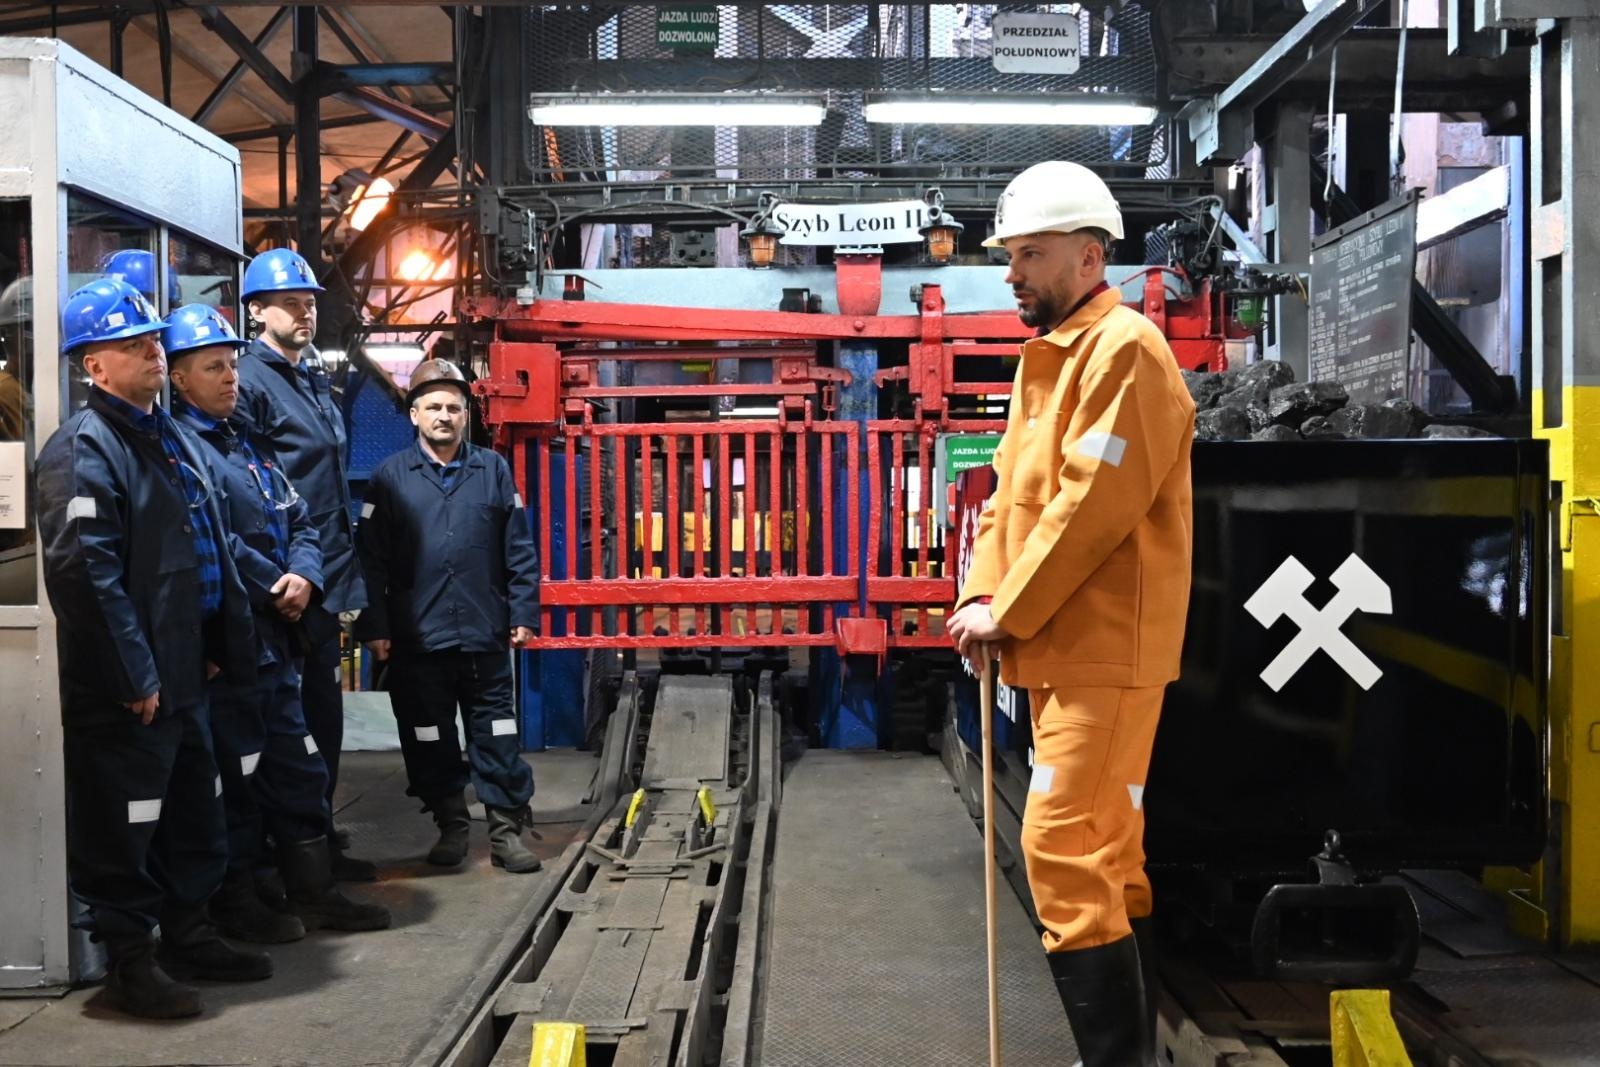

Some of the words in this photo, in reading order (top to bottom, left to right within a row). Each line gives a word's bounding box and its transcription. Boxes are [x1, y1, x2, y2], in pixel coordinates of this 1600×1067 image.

[659, 11, 689, 23] JAZDA
[690, 11, 718, 23] LUDZI
[659, 31, 717, 43] DOZWOLONA
[1002, 27, 1069, 37] PRZEDZIAŁ
[994, 47, 1077, 57] POŁUDNIOWY
[776, 212, 830, 237] Szyb
[838, 213, 896, 232] Leon
[905, 209, 922, 229] II
